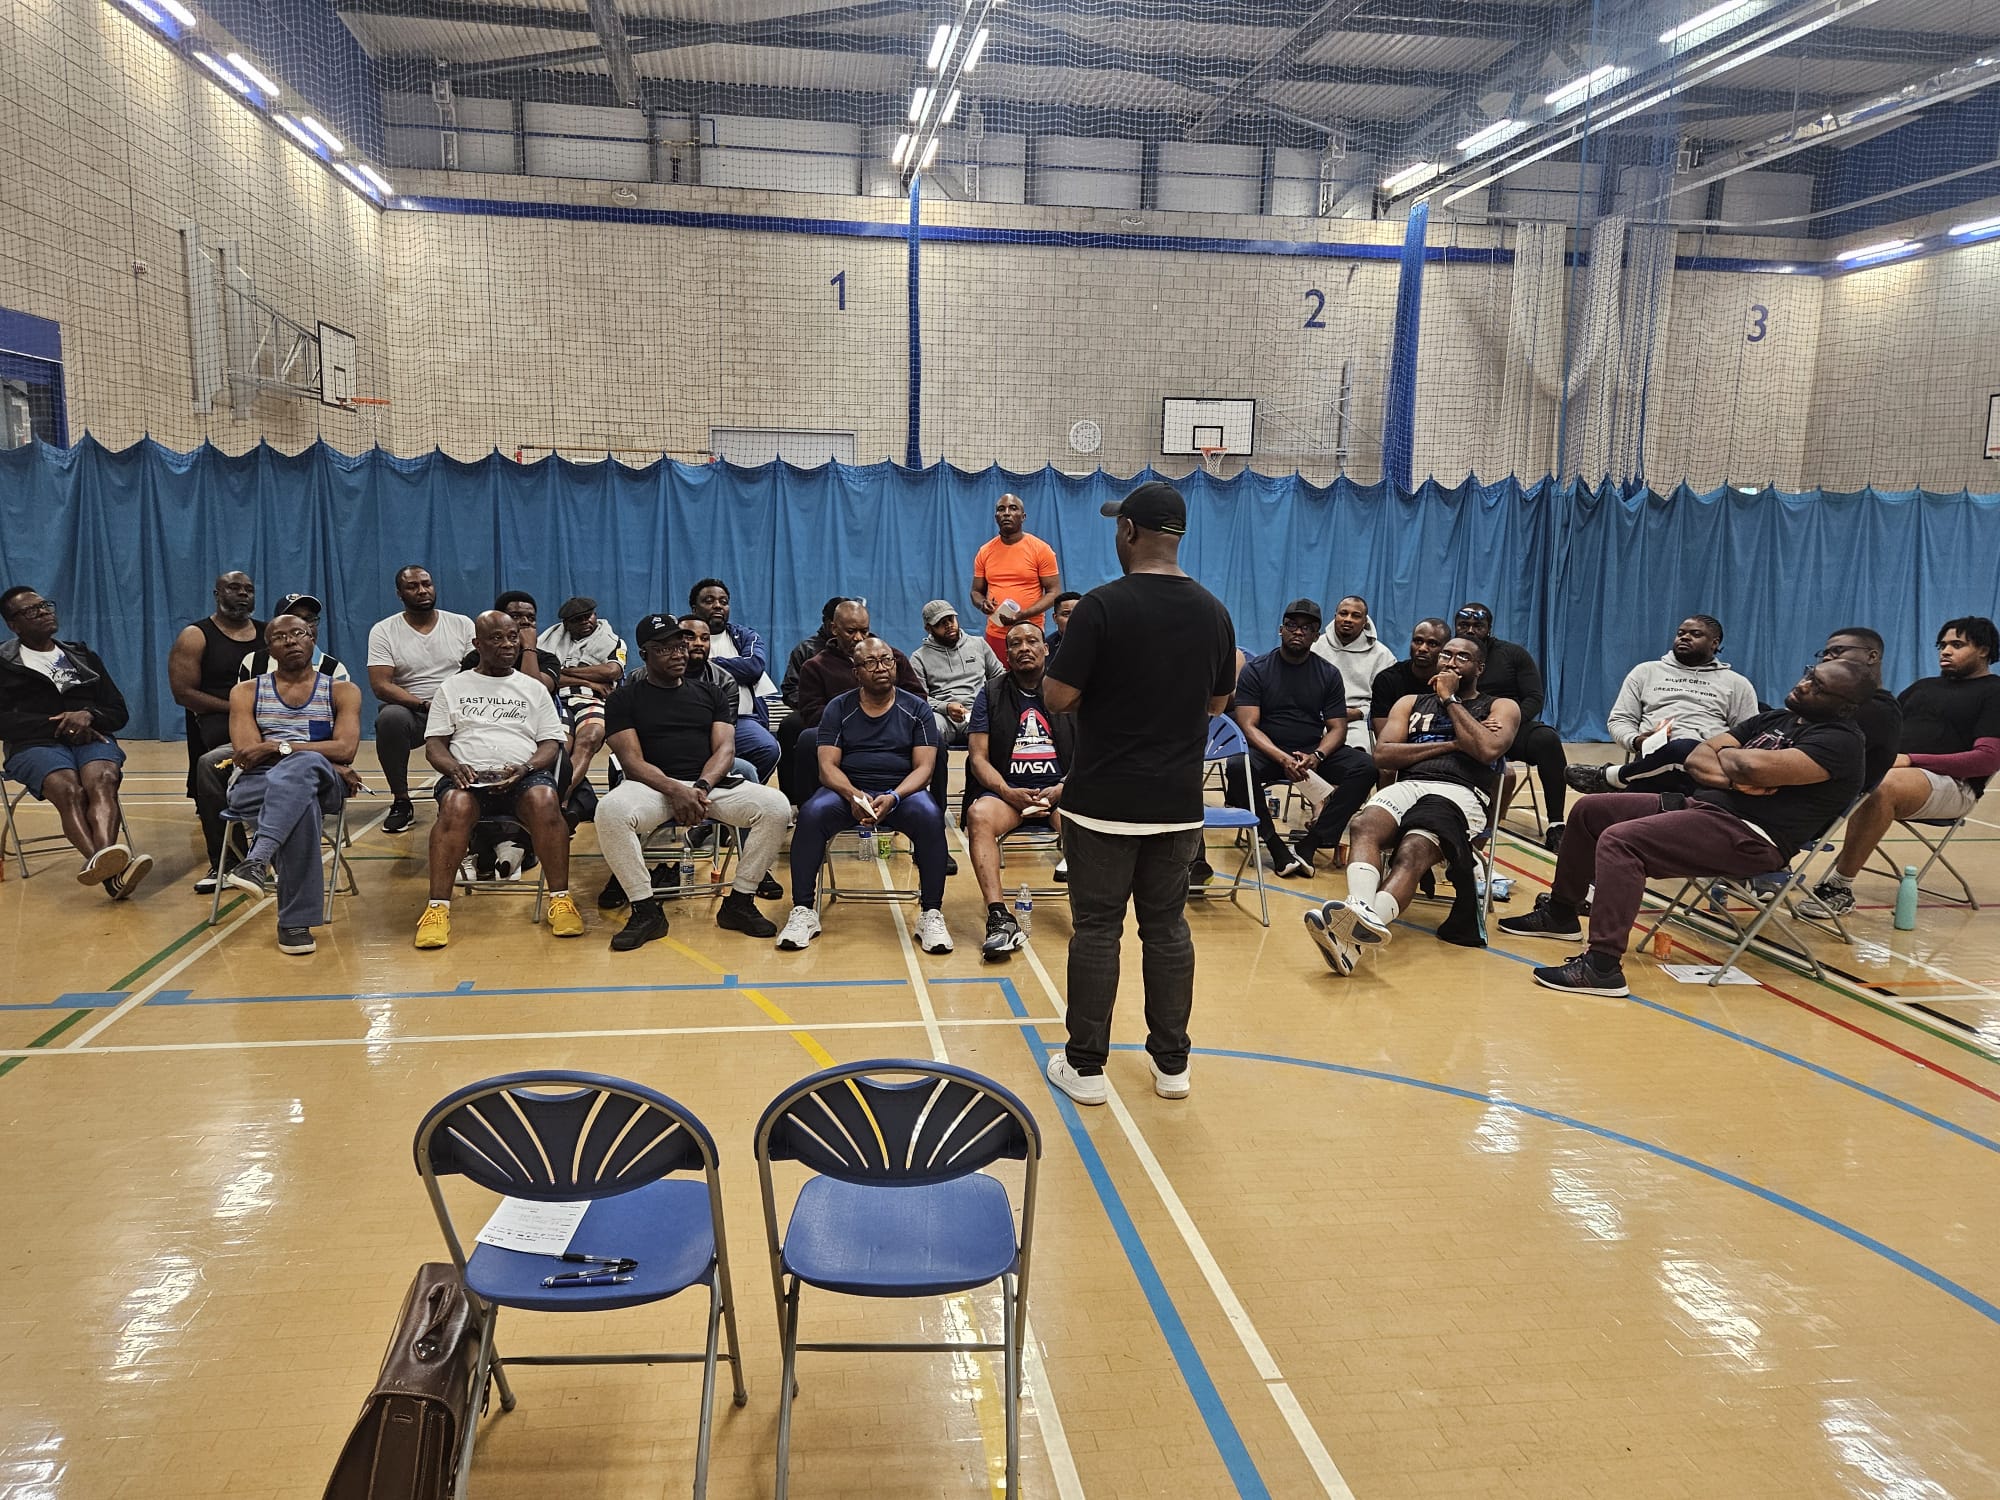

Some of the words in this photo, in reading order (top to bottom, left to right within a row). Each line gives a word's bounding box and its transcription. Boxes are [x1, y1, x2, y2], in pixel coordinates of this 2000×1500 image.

[830, 270, 846, 311] 1
[1303, 288, 1327, 329] 2
[1747, 304, 1769, 342] 3
[459, 696, 485, 705] EAST
[487, 697, 527, 709] VILLAGE
[1408, 711, 1435, 735] 21
[1010, 761, 1056, 774] NASA
